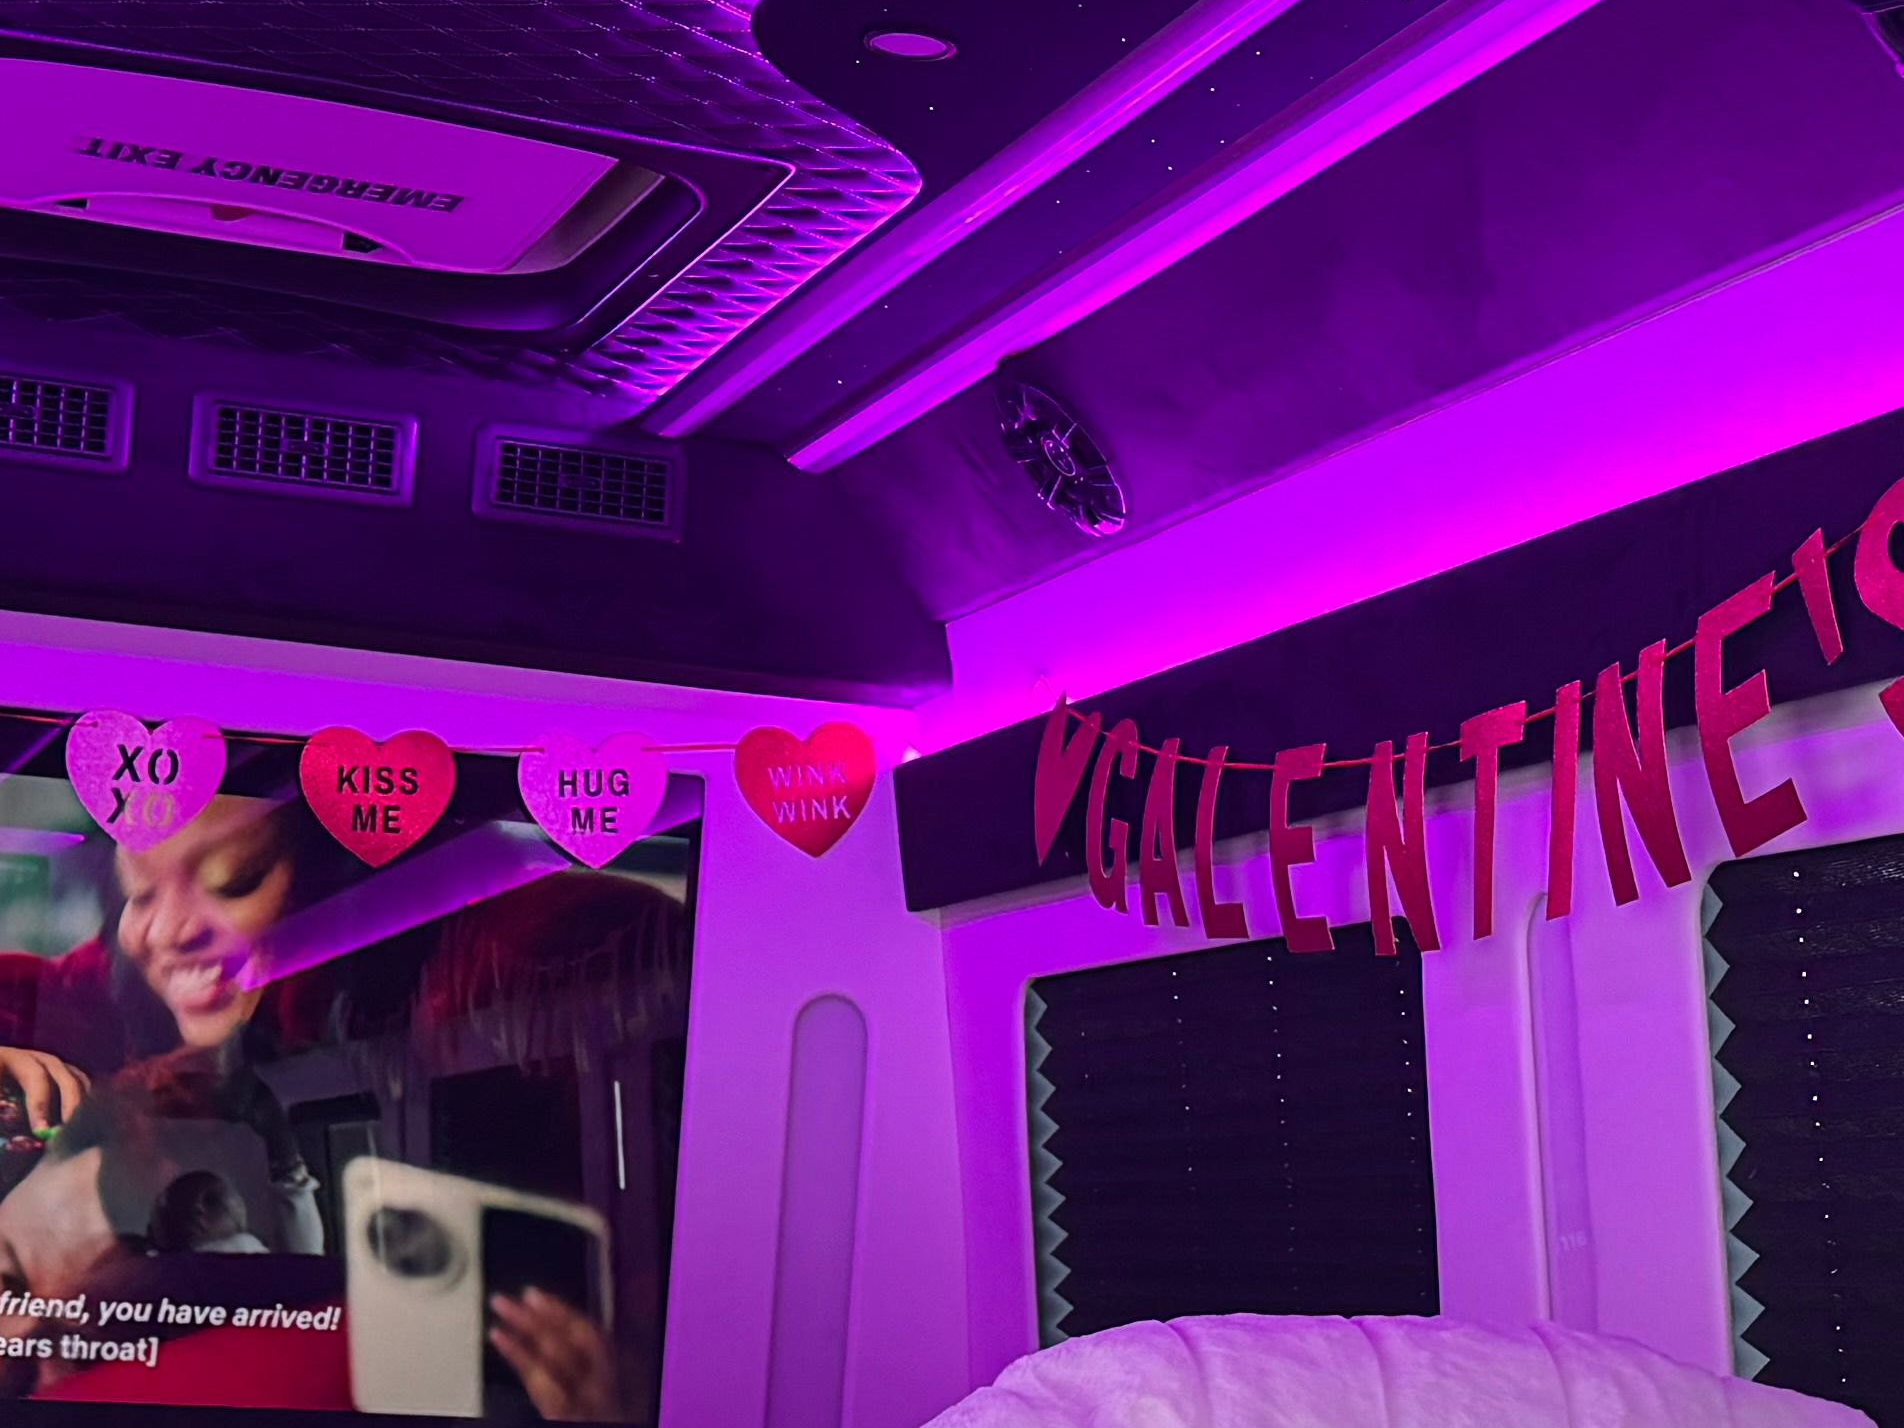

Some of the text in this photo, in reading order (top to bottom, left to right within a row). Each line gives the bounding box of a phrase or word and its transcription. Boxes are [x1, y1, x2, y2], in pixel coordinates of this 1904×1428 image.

[72, 136, 464, 213] EMERGENCY EXIT
[112, 743, 180, 786] XO
[767, 763, 847, 791] WINK
[337, 765, 419, 796] KISS
[558, 768, 630, 798] HUG
[351, 804, 401, 835] ME
[571, 807, 619, 836] ME
[772, 795, 851, 823] WINK
[98, 1300, 152, 1327] you
[157, 1298, 227, 1326] have
[231, 1303, 342, 1331] arrived!
[59, 1334, 159, 1368] throat]
